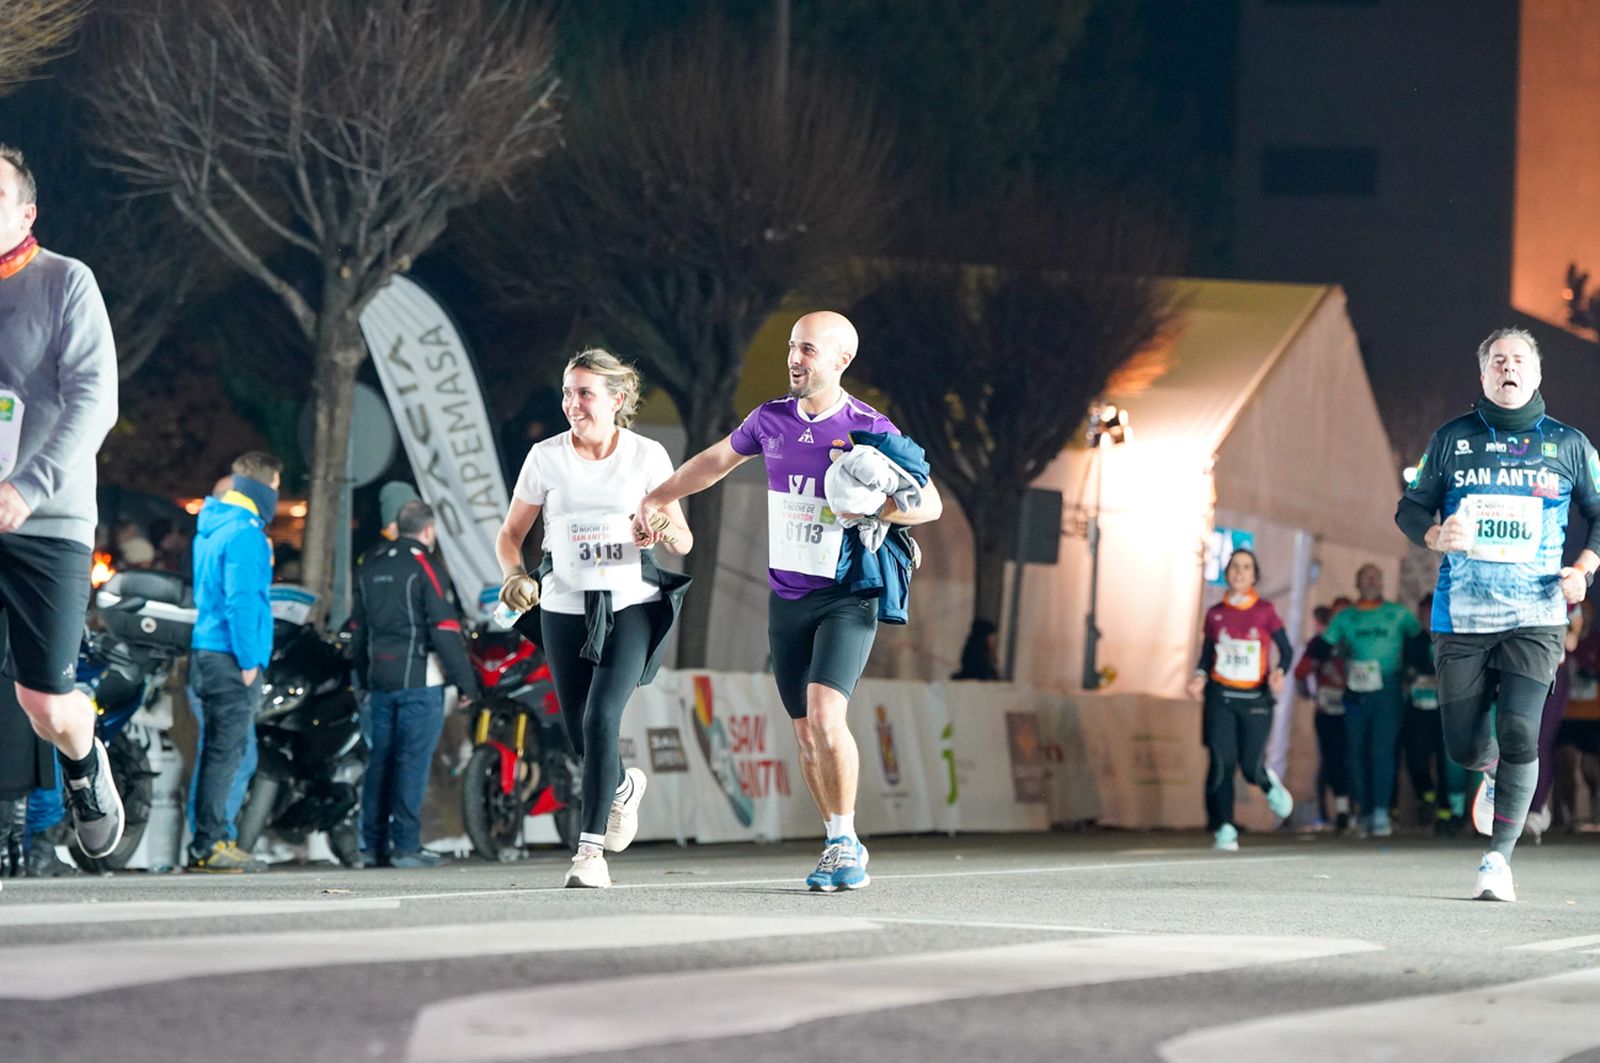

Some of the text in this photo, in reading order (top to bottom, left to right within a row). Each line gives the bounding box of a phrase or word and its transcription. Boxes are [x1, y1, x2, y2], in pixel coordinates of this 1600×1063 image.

[418, 324, 500, 525] JAPEMASA
[1454, 467, 1492, 488] SAN
[1496, 467, 1560, 492] ANTÓN
[579, 542, 623, 561] 3113
